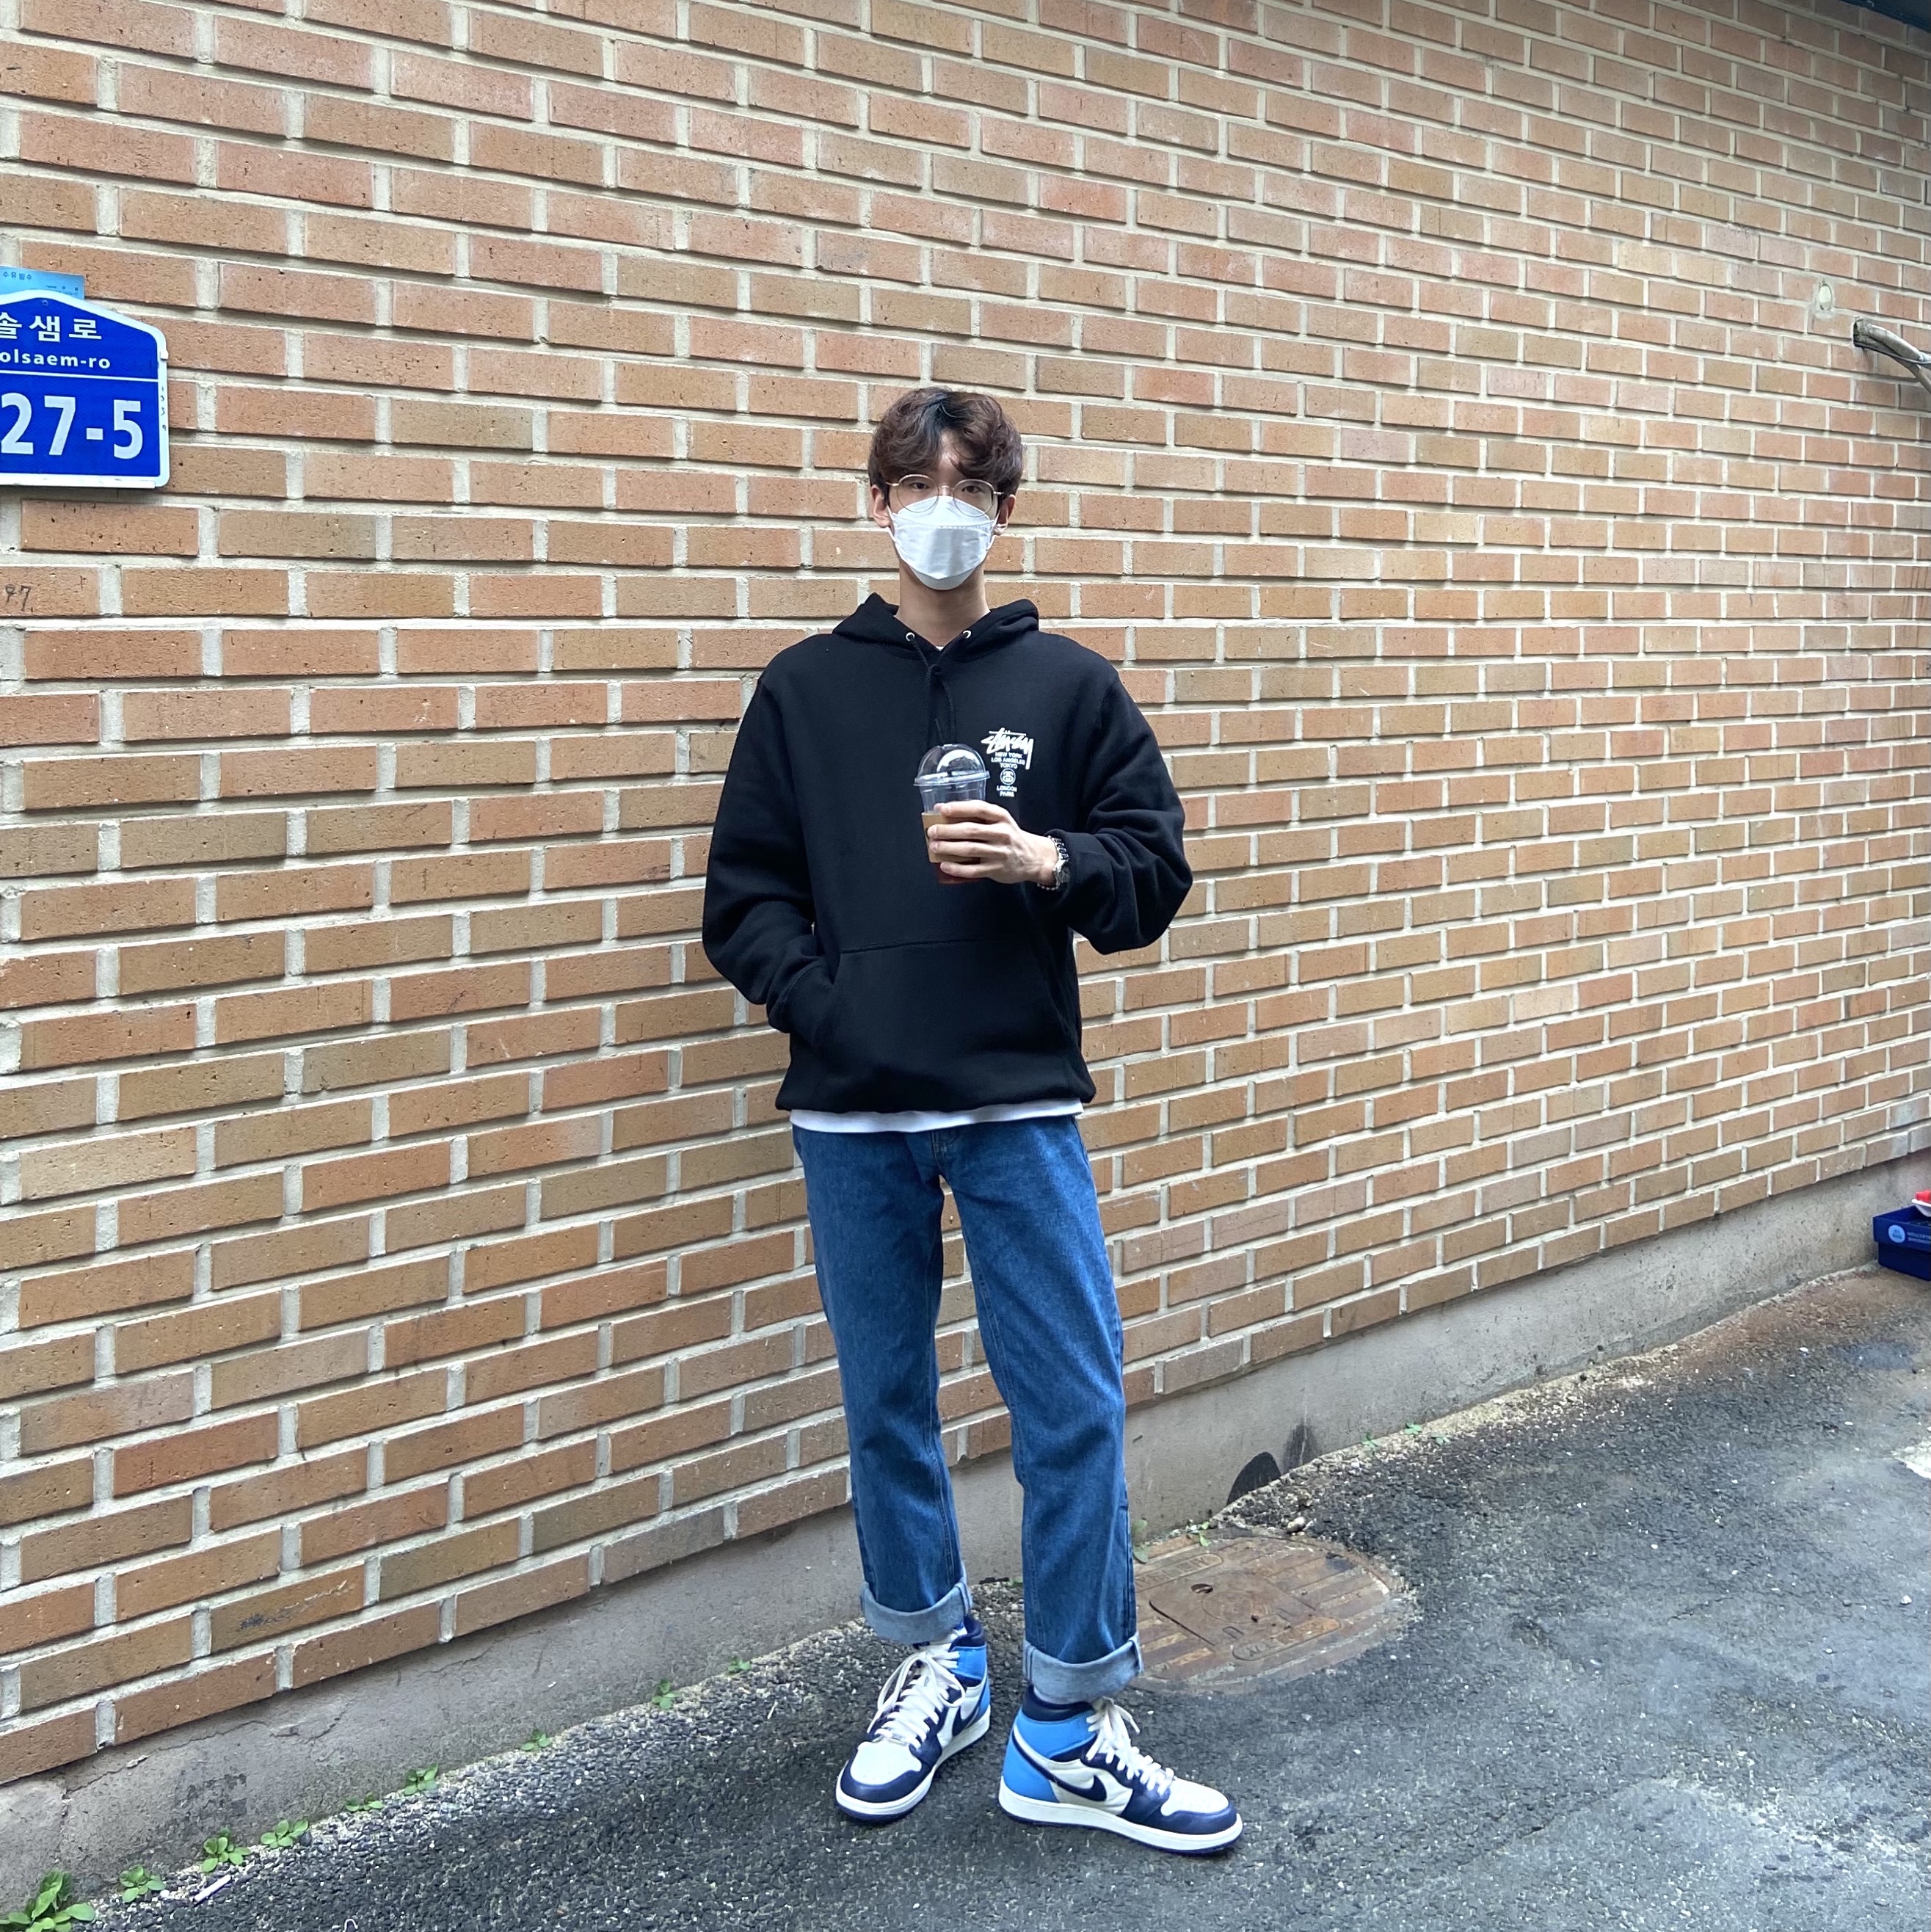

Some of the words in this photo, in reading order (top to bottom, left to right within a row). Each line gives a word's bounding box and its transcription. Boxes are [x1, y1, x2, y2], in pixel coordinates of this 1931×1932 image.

[0, 312, 102, 343] 솔샘로
[0, 349, 111, 369] olsaem-ro
[1, 392, 144, 460] 27-5
